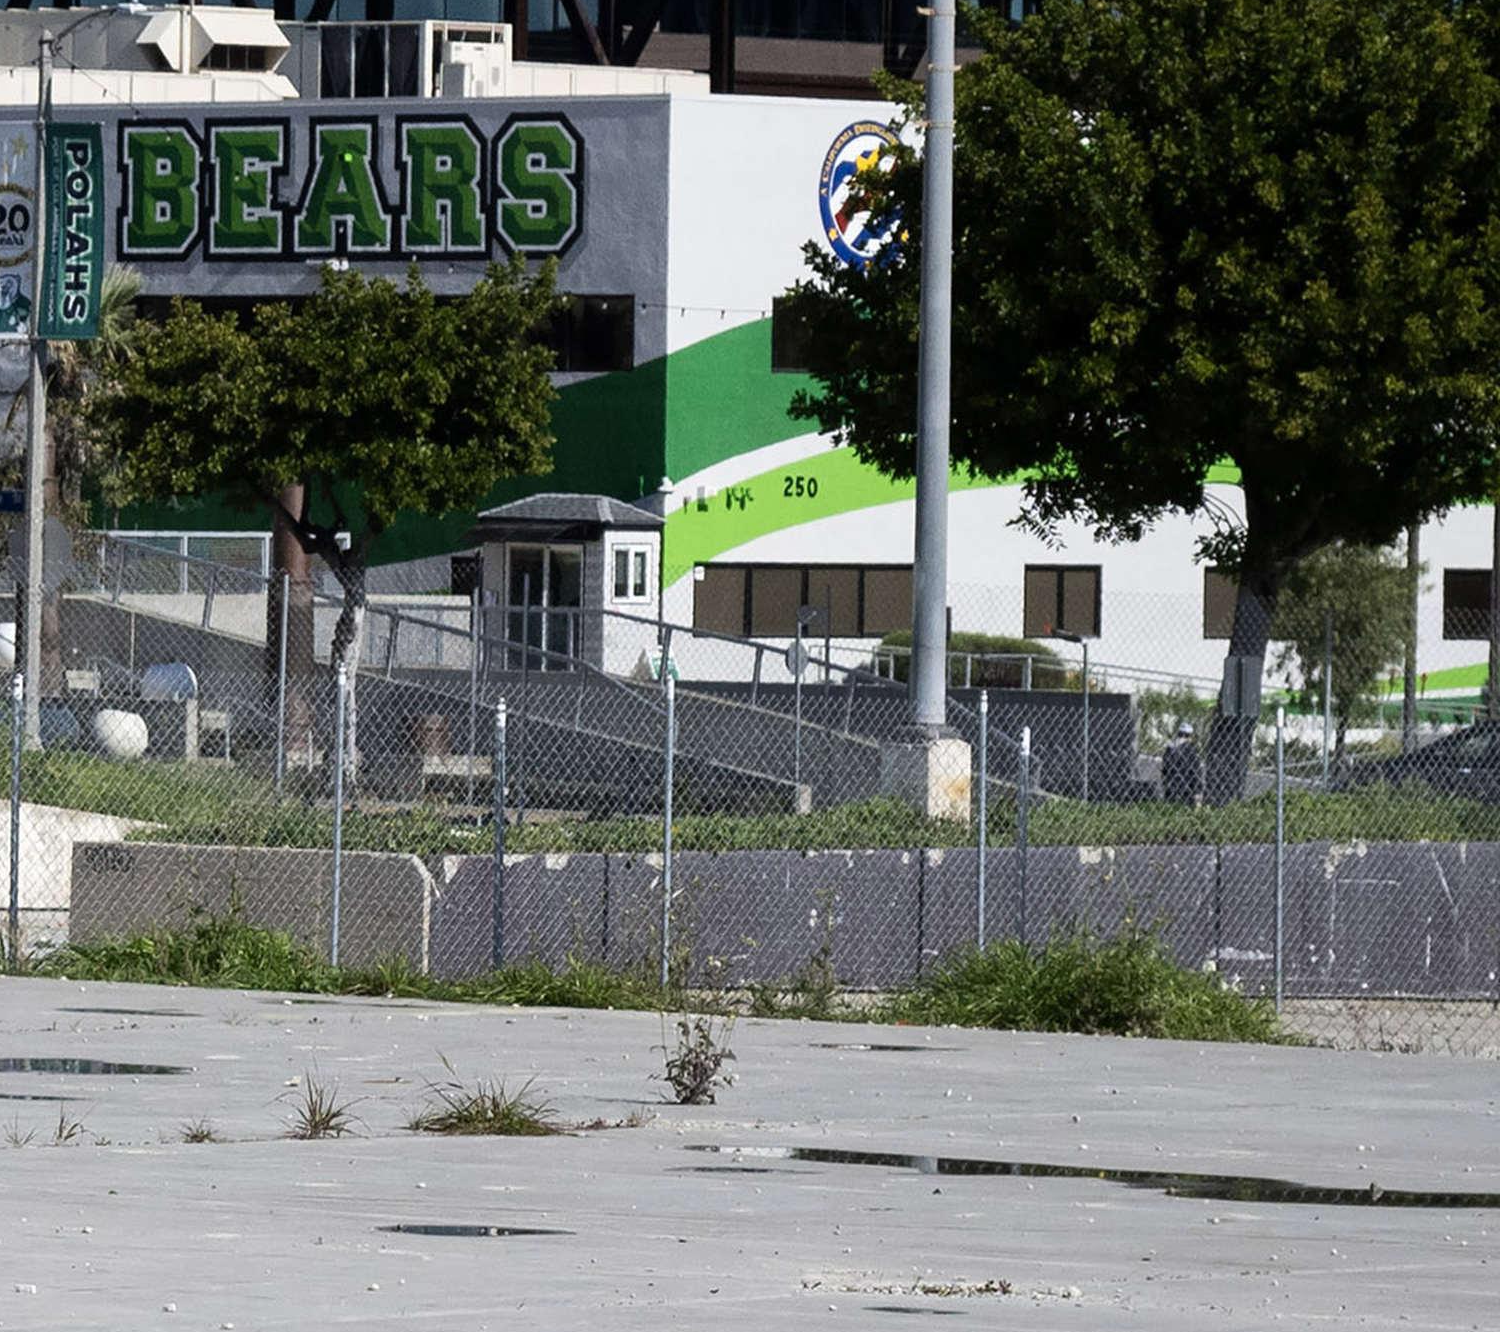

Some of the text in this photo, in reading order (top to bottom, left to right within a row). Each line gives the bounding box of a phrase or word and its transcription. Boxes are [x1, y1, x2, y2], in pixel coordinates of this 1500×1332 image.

[62, 139, 92, 324] POLAHS
[117, 112, 585, 261] BEARS
[783, 475, 819, 498] 250
